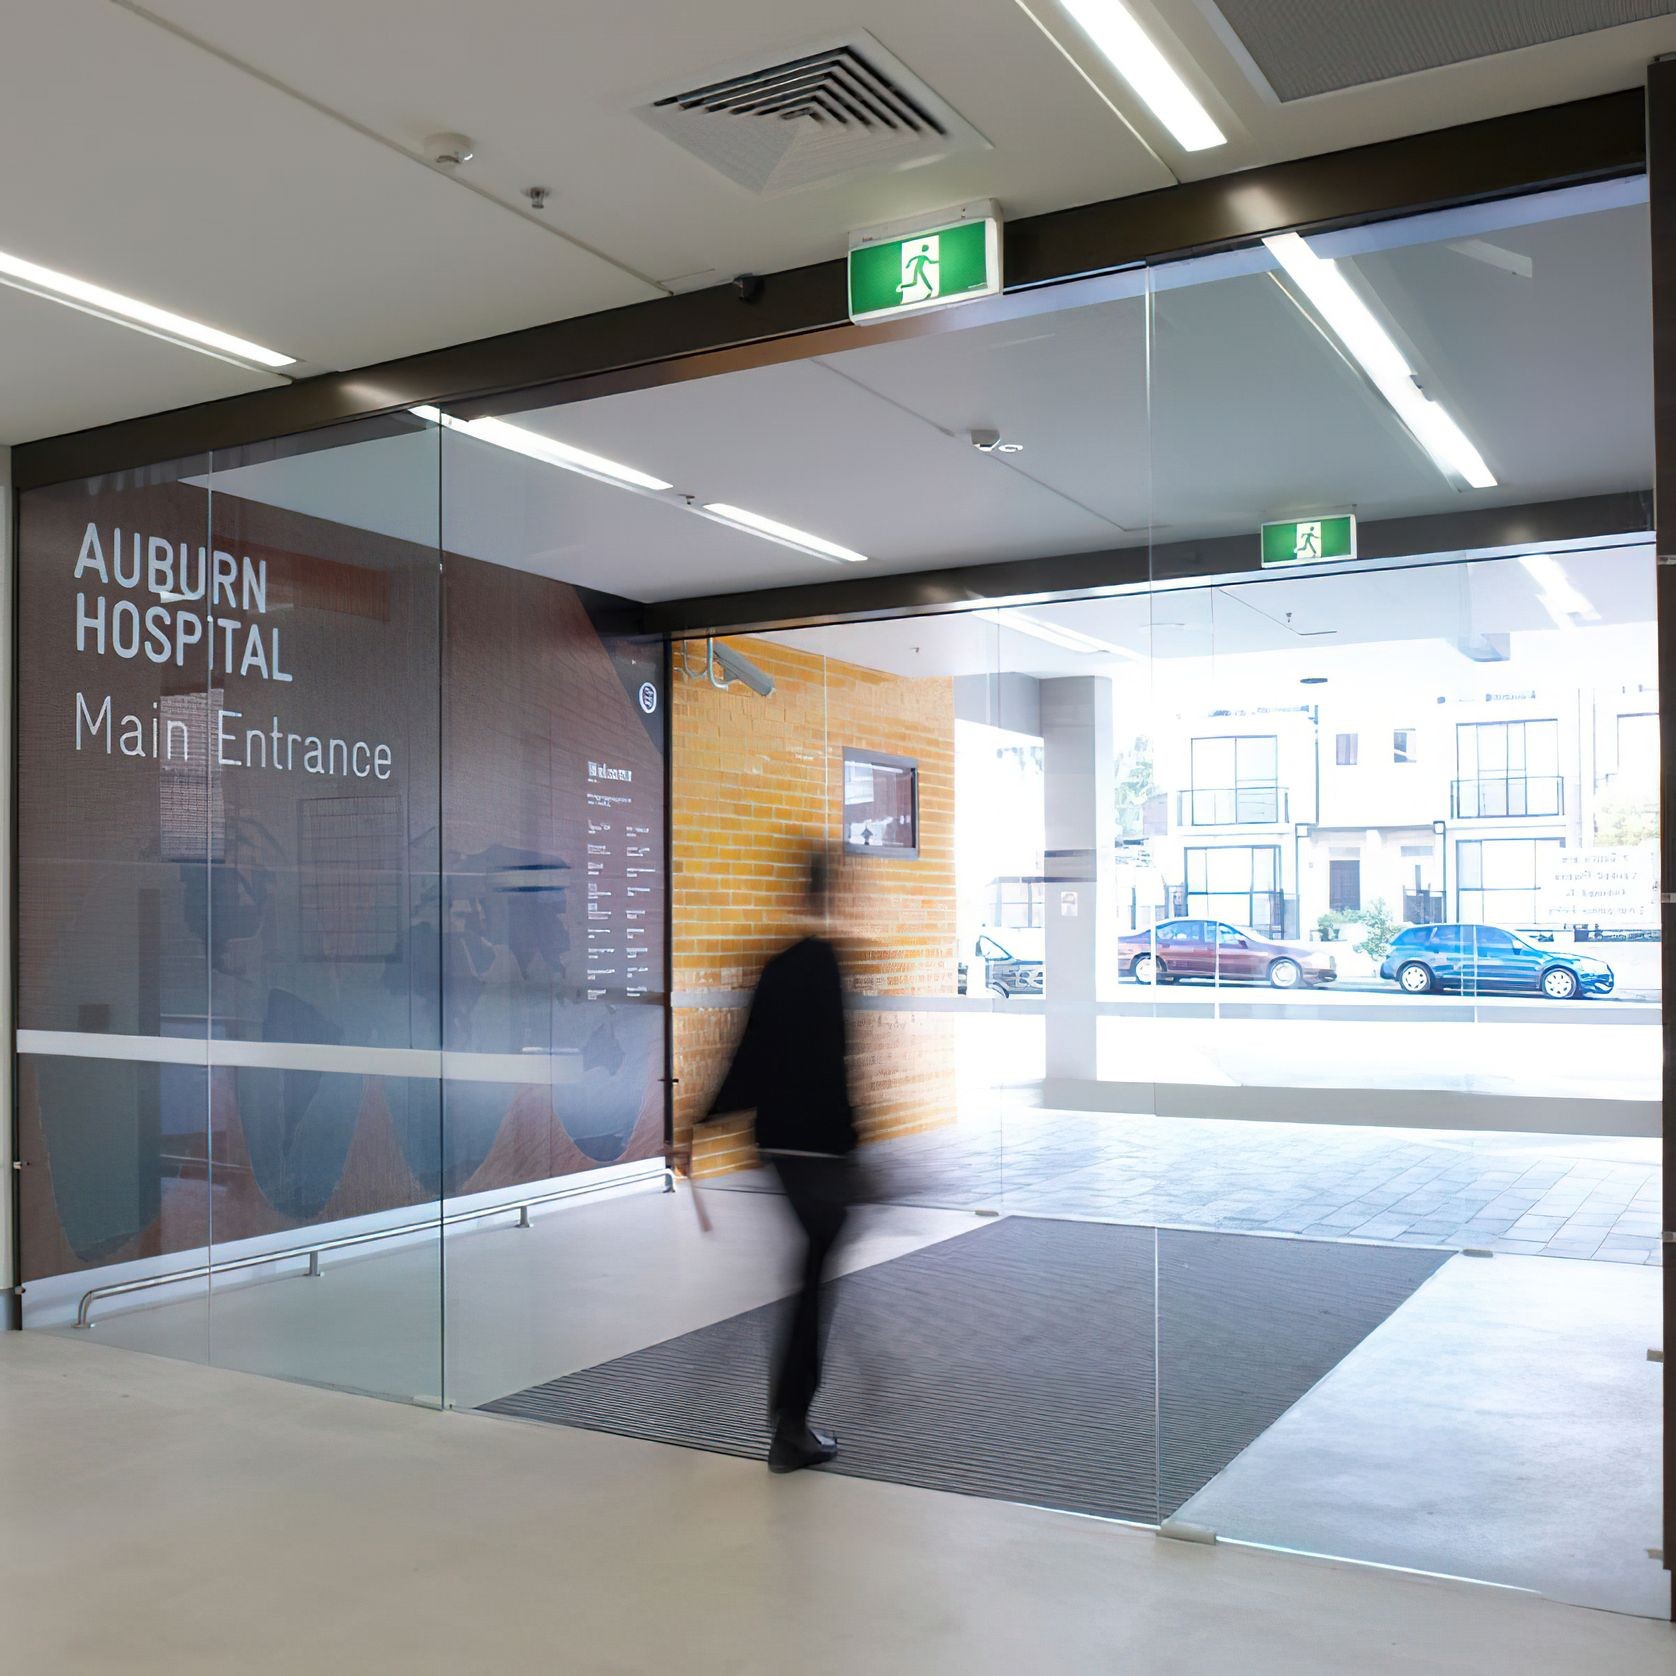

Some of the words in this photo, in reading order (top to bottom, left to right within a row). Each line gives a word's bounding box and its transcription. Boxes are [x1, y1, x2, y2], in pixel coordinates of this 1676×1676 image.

[73, 522, 267, 614] AUBURN
[76, 592, 293, 682] HOSPITAL
[75, 692, 188, 761] Main
[217, 710, 392, 780] Entrance
